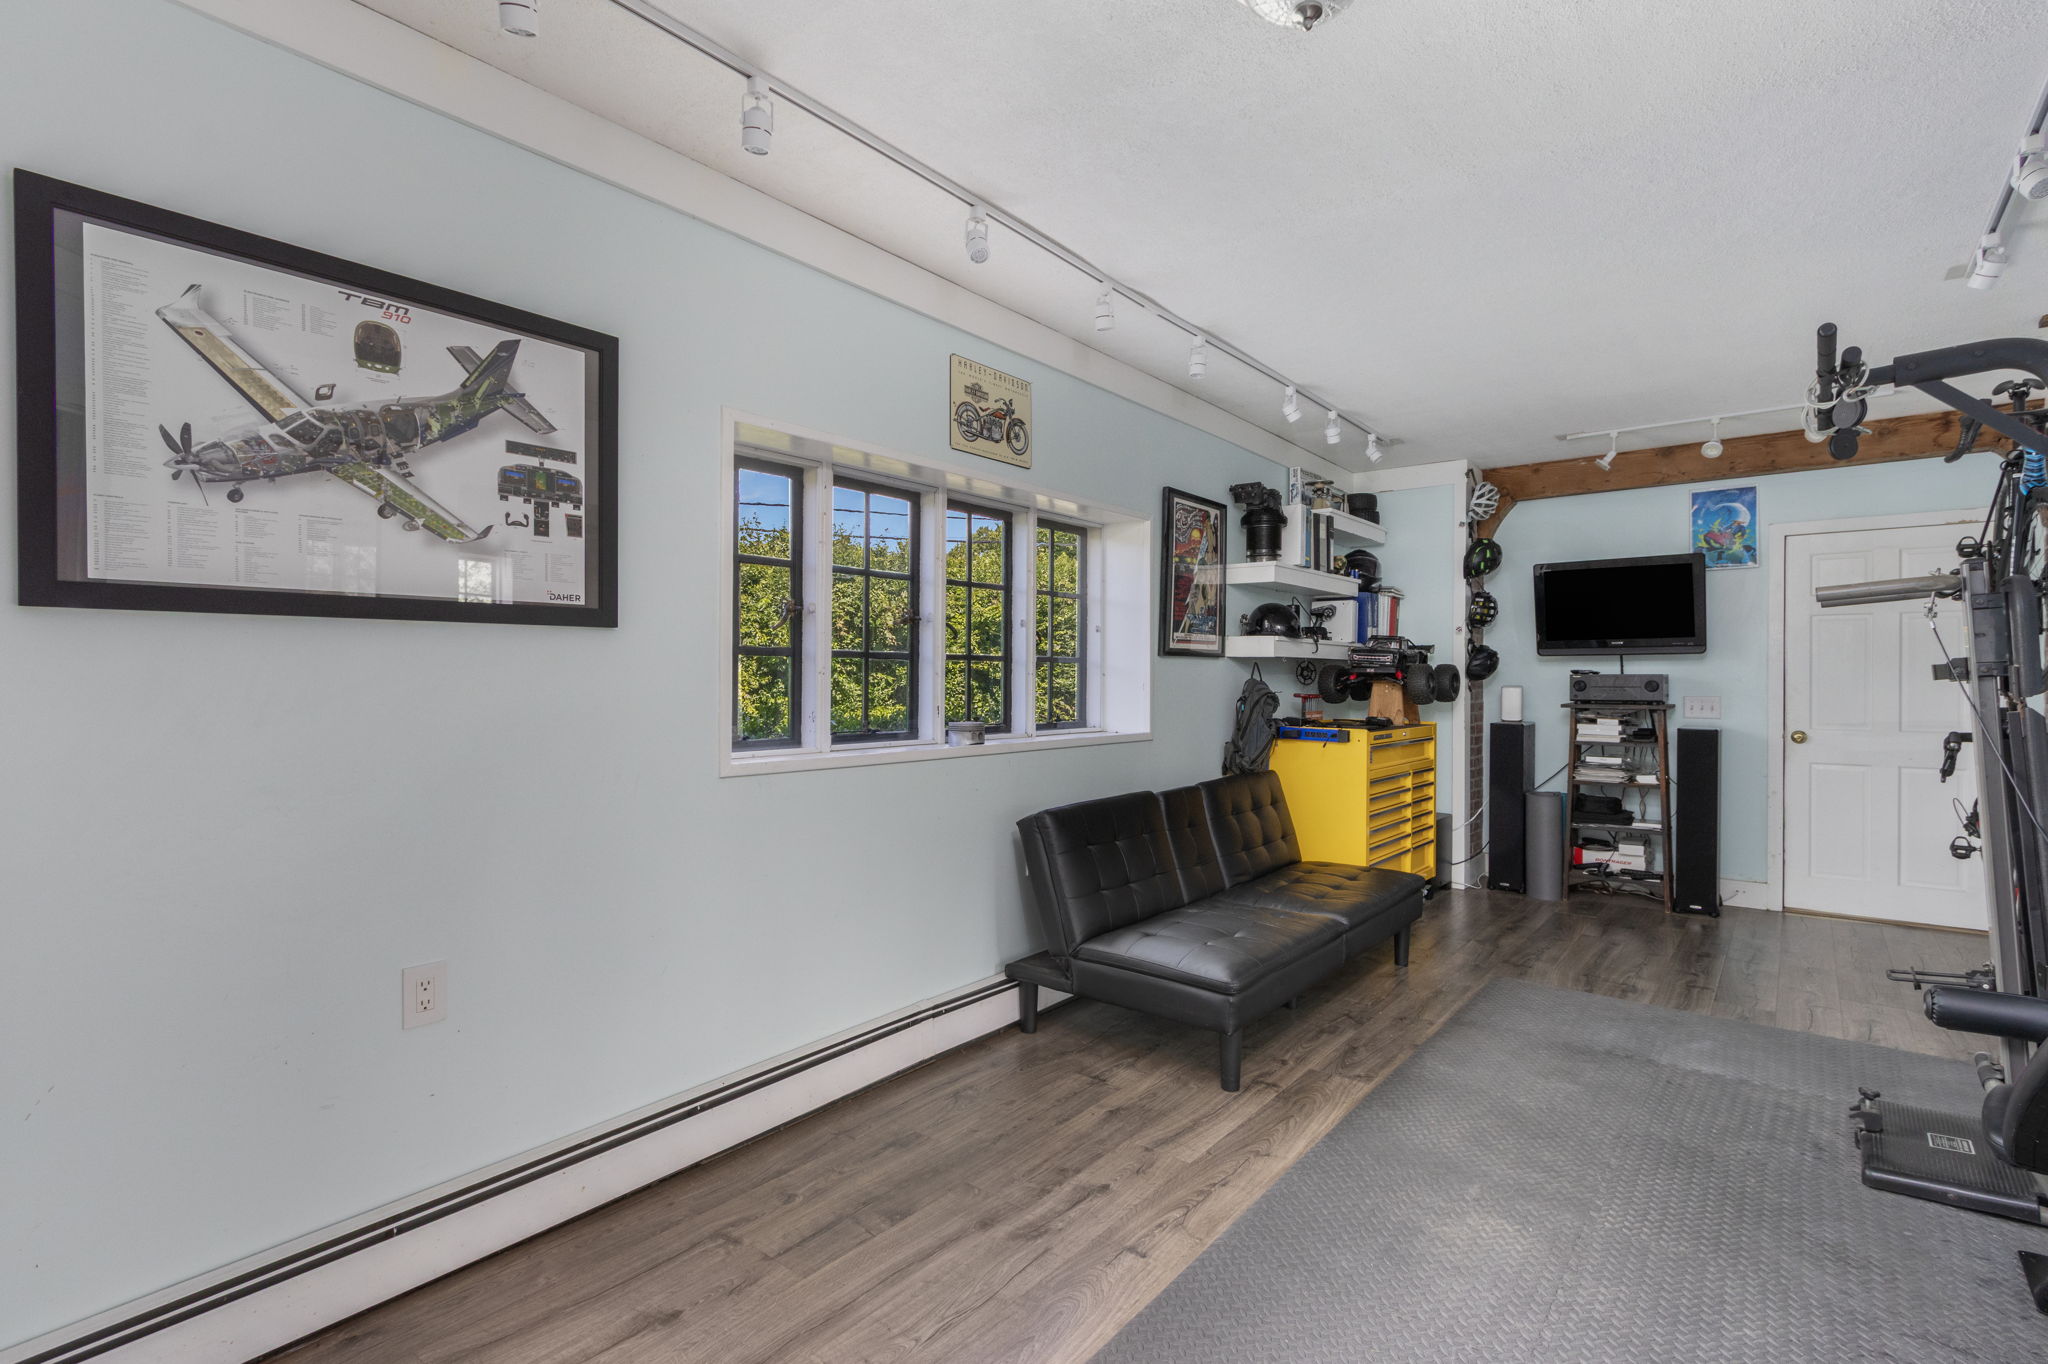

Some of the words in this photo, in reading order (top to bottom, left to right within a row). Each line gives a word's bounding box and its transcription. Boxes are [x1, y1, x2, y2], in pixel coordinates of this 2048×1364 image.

[338, 291, 409, 315] TBM
[381, 311, 411, 324] 910
[957, 360, 1029, 392] HARLEY-DAVIDSON
[548, 593, 582, 602] DAHER
